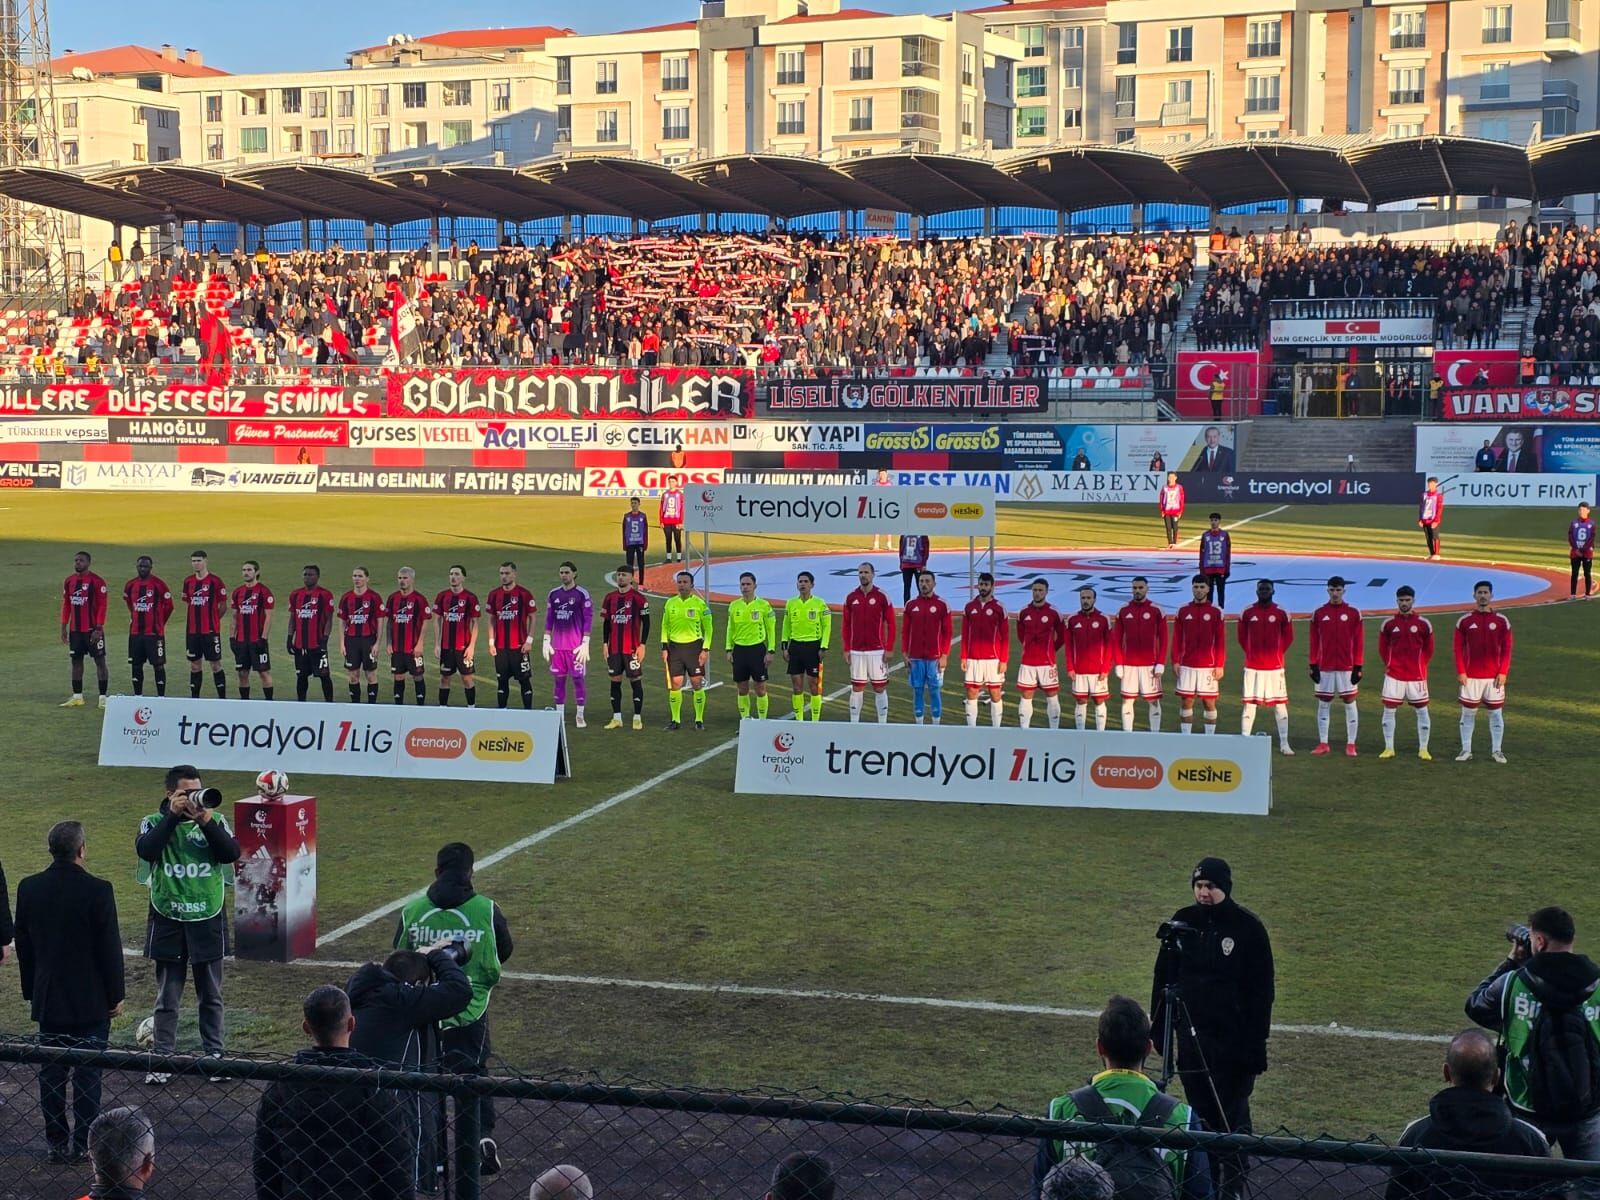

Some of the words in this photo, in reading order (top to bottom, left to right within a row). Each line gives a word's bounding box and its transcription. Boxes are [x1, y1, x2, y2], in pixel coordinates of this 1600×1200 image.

[0, 385, 90, 411] İLLERE
[108, 386, 246, 416] DÜŞECEĞİZ
[263, 388, 369, 414] SENİNLE
[403, 370, 743, 416] GÖLKENTLİLER
[770, 380, 839, 408] LİSELİ
[870, 380, 1040, 408] GÖLKENTLİLER
[1451, 393, 1520, 415] VAN
[129, 419, 206, 435] HANOĞLU
[235, 424, 270, 441] Güven
[423, 427, 472, 442] VESTEL
[774, 426, 811, 442] UKY
[818, 426, 860, 442] YAPI
[483, 427, 526, 450] AÇI
[529, 422, 597, 442] KOLEJİ
[97, 464, 182, 477] MARYAP
[242, 472, 316, 484] VANGÖLÜ
[588, 469, 626, 488] 2A
[319, 471, 374, 488] AZELİN
[377, 472, 446, 488] GELİNLİK
[454, 472, 508, 490] FATİH
[512, 472, 581, 494] ŞEVGİN
[964, 473, 1010, 493] VAN
[1051, 474, 1160, 490] MABEYN
[1248, 479, 1332, 497] trendyol
[1459, 483, 1530, 498] TURGUT
[1539, 485, 1588, 498] FIRAT
[668, 496, 676, 508] 9
[736, 495, 847, 522] trendyol
[632, 521, 639, 532] 5
[1578, 528, 1587, 540] 6
[1208, 541, 1222, 554] 13
[260, 654, 268, 663] 10
[414, 657, 423, 667] 18
[521, 662, 530, 672] 53
[124, 727, 160, 738] trendyol
[178, 715, 324, 755] trendyol
[410, 735, 462, 750] trendyol
[762, 753, 804, 766] trendyol
[826, 742, 995, 786] trendyol
[1097, 764, 1157, 780] trendyol
[164, 862, 212, 878] 0902
[170, 902, 207, 912] PRESS
